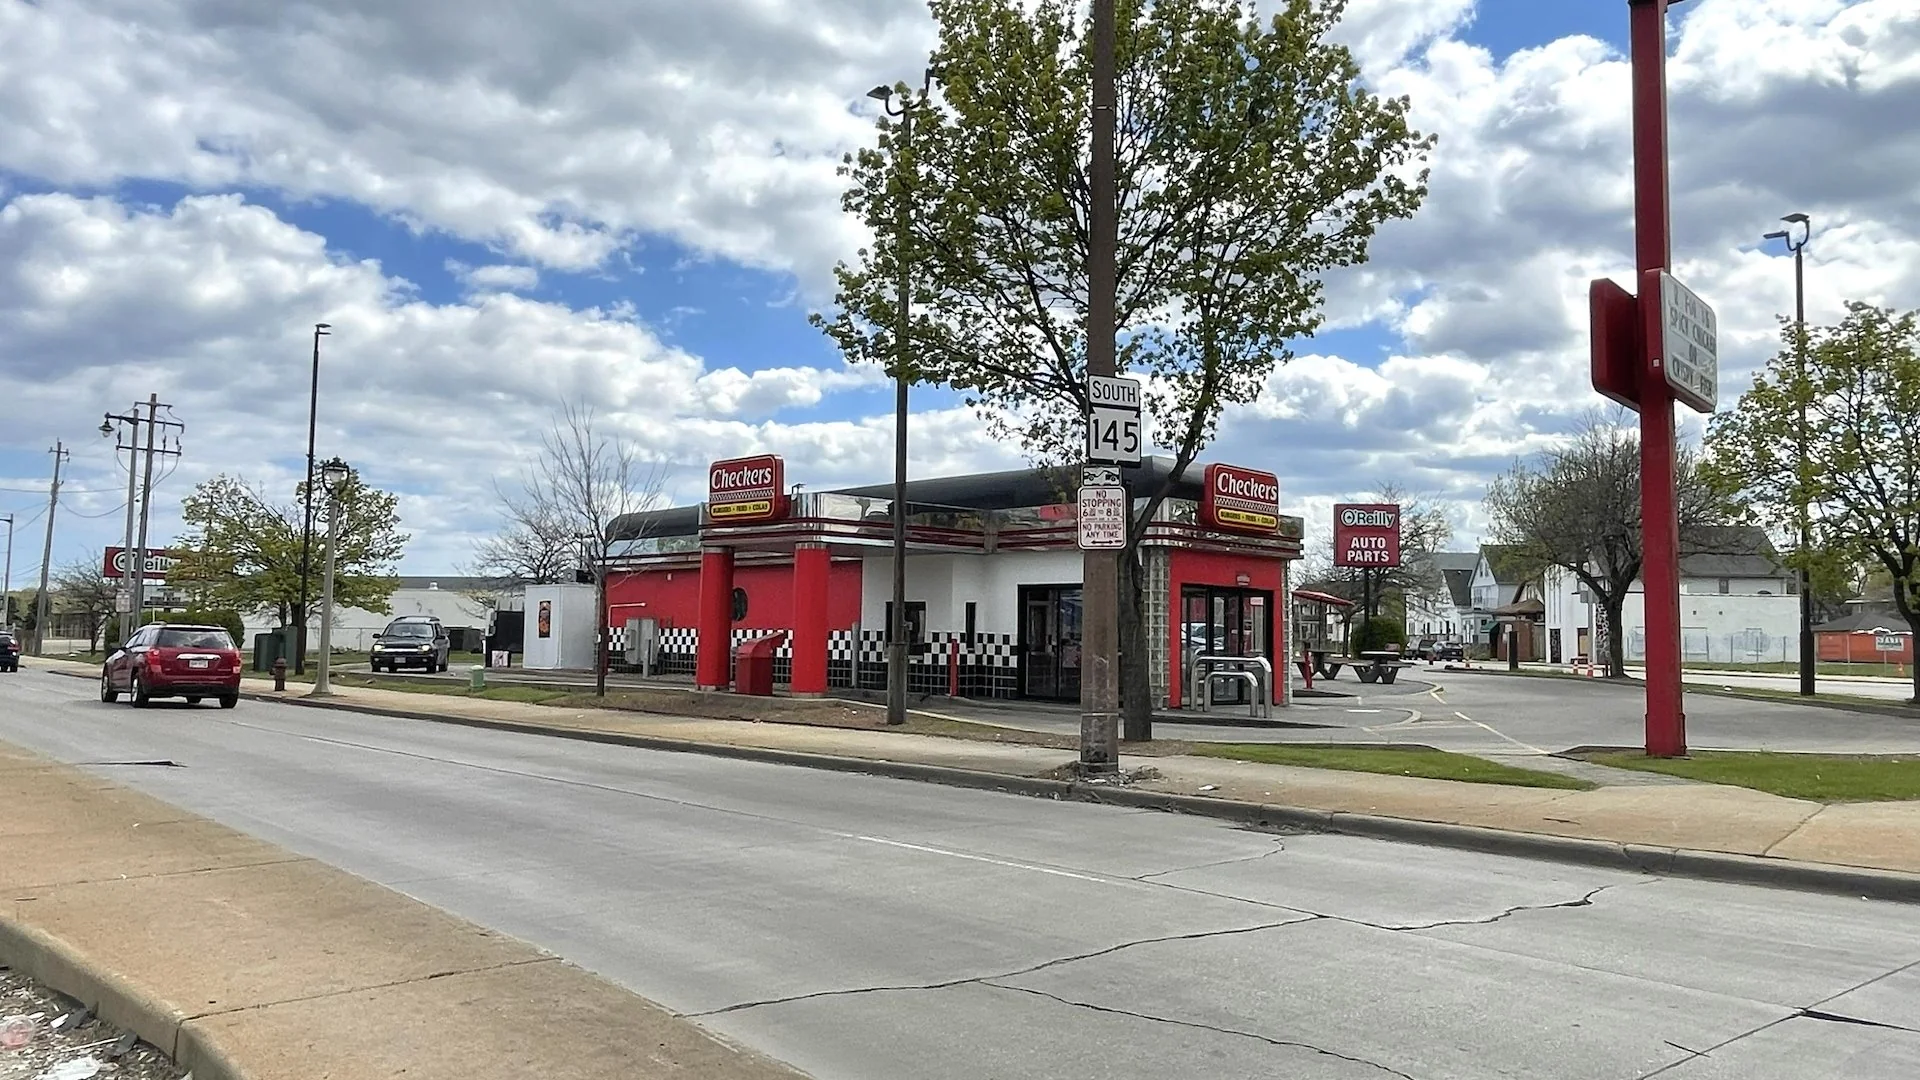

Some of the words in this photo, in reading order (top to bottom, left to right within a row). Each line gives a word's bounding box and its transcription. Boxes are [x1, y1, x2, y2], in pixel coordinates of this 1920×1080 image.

[1092, 380, 1136, 403] SOUTH
[1093, 418, 1138, 453] 145
[711, 466, 772, 489] Checkers
[1217, 472, 1277, 500] Checkers
[1096, 490, 1107, 498] NO
[1082, 499, 1121, 508] STOPPING
[1341, 509, 1395, 528] O'Reilly
[1082, 523, 1092, 531] NO
[1095, 523, 1121, 531] PARKING
[1351, 537, 1386, 548] AUTO
[1347, 550, 1389, 562] PARTS
